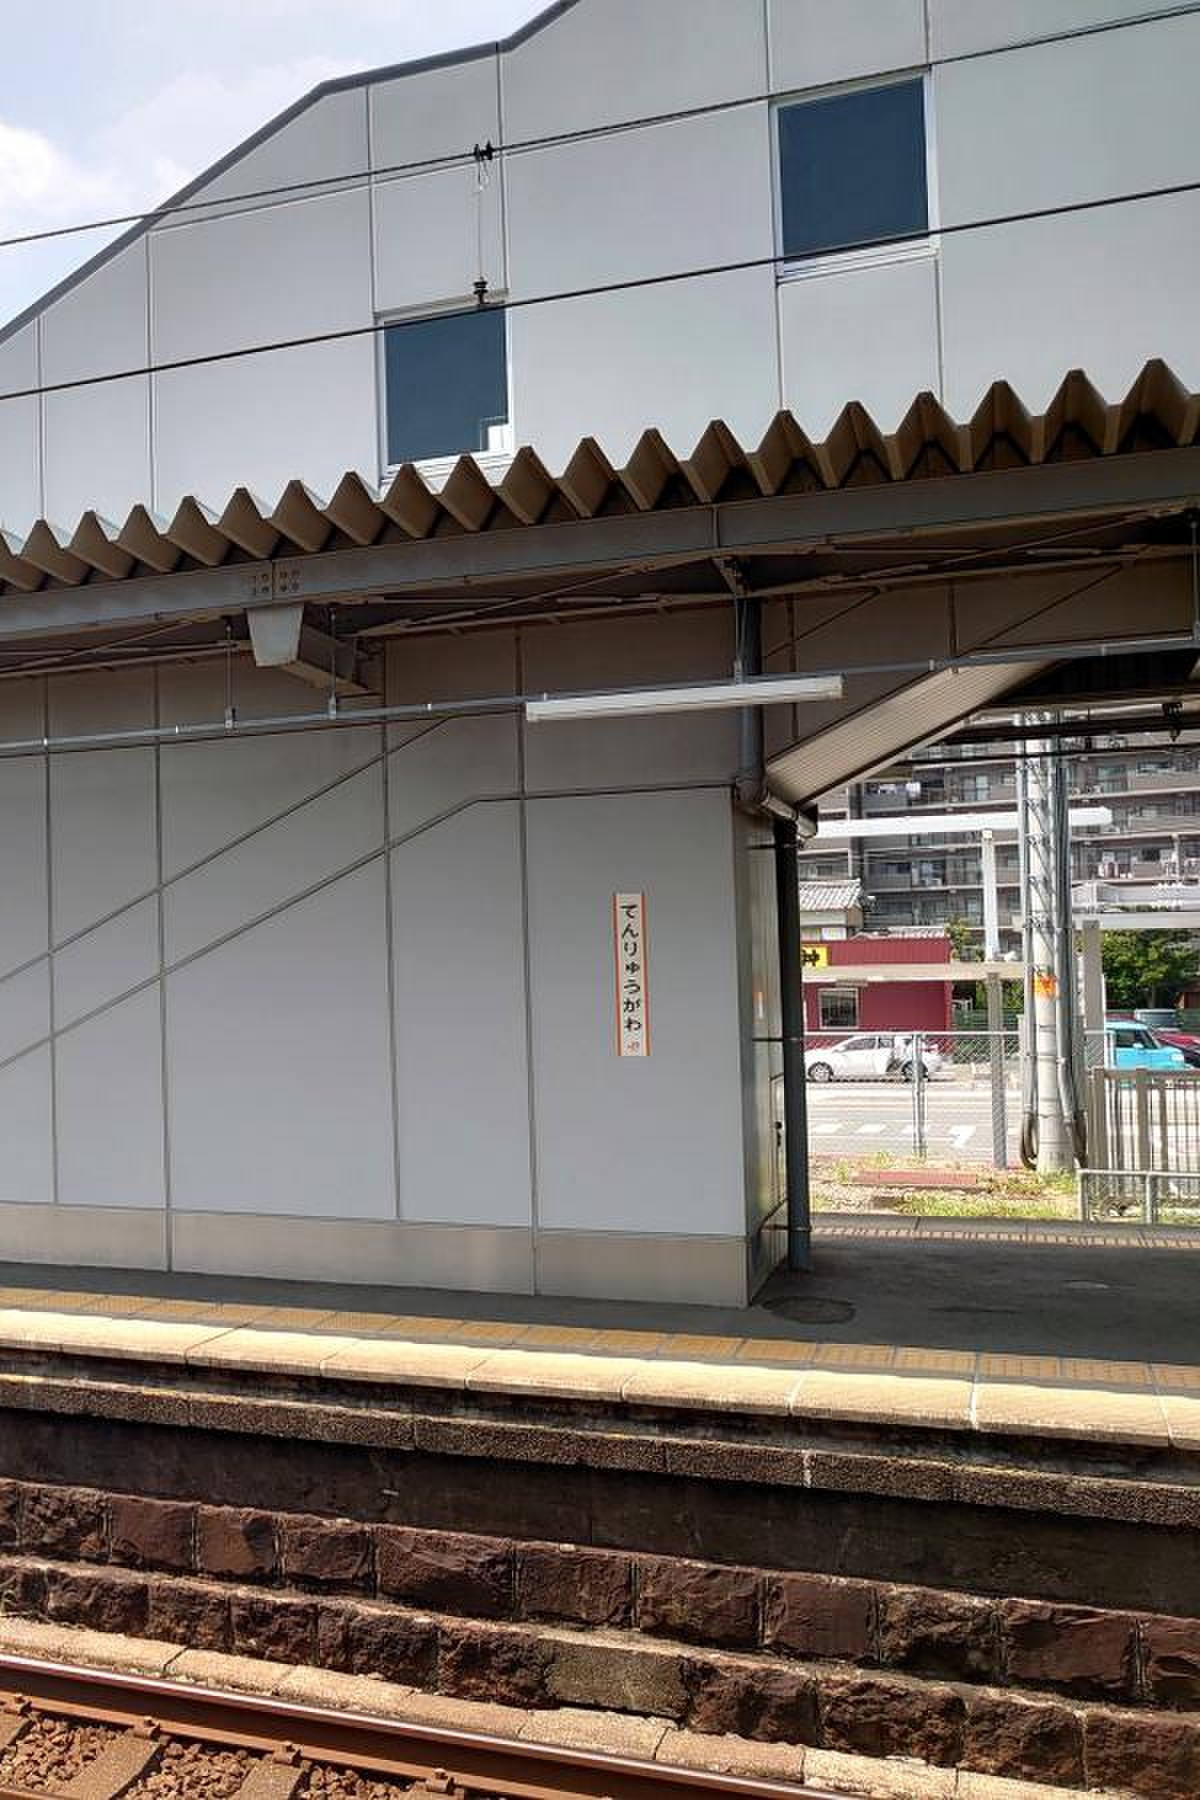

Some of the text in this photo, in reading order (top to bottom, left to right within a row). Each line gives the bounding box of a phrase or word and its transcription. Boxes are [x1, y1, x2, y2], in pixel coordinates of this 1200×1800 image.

[619, 903, 643, 1032] てんりゅうがわ
